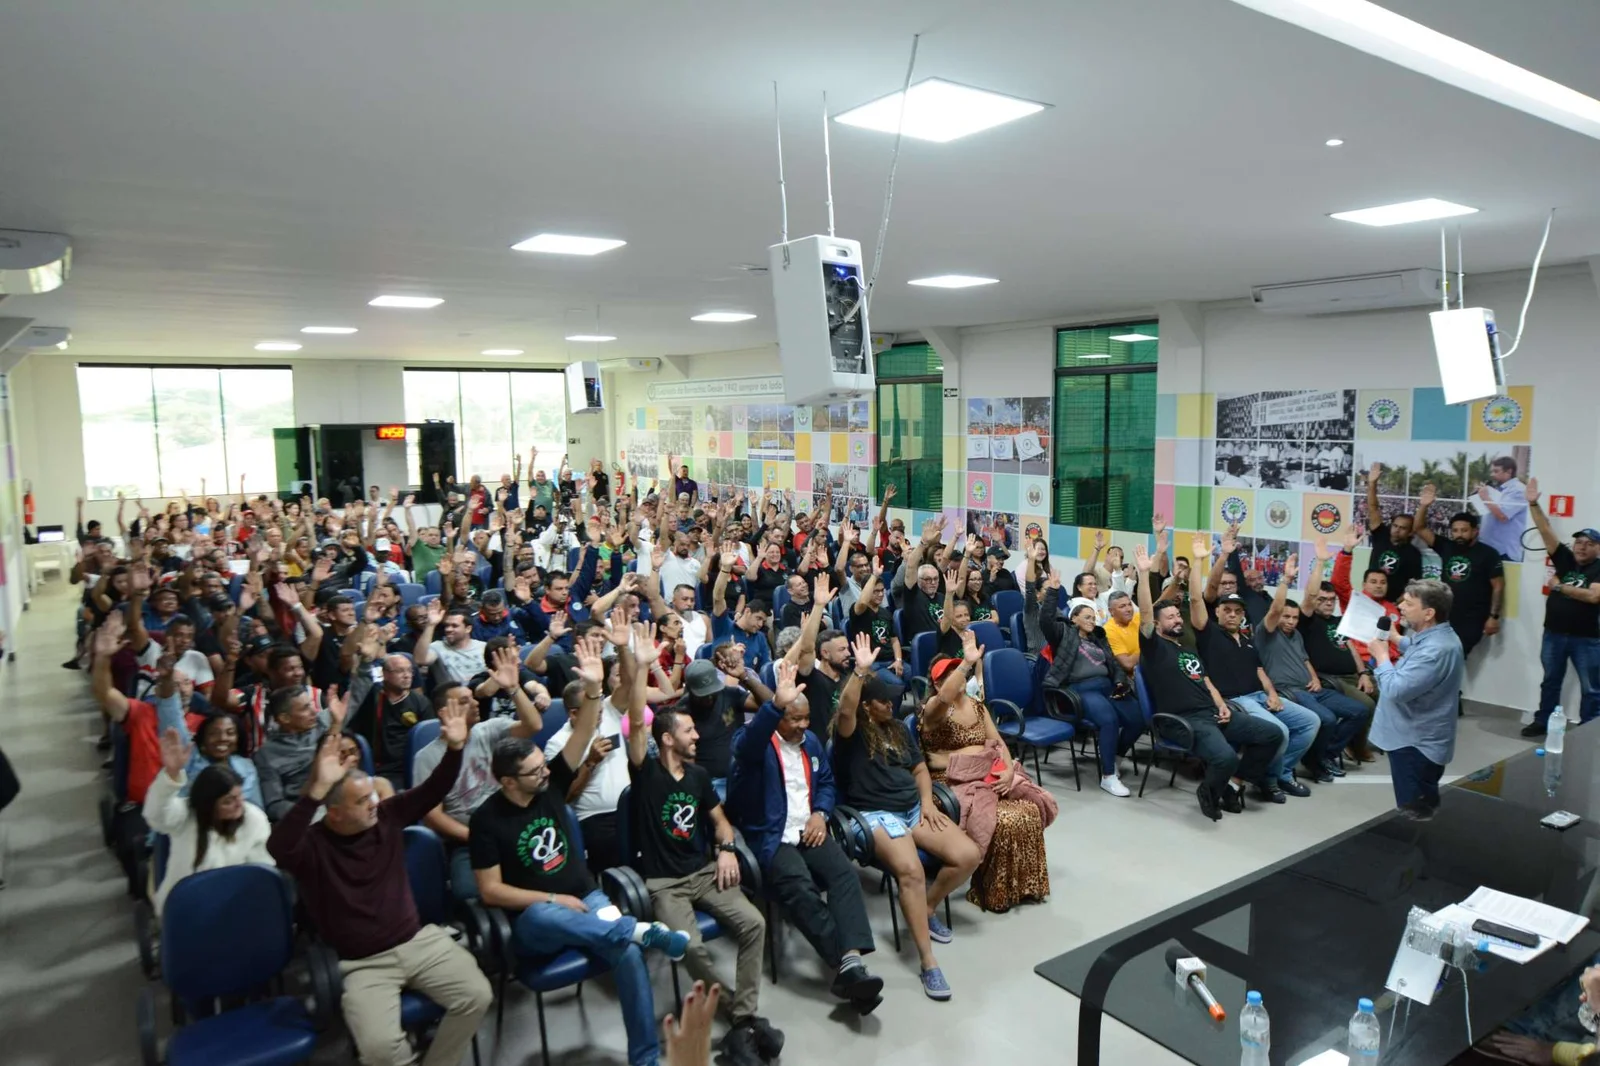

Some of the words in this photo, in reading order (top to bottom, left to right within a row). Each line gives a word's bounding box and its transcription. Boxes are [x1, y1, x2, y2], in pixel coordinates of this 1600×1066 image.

[707, 384, 724, 393] Desde
[724, 383, 738, 392] 1942
[739, 383, 759, 393] sempre
[760, 383, 768, 391] ao
[768, 381, 783, 390] lado
[1184, 658, 1202, 674] 82
[673, 803, 695, 829] 82
[528, 826, 564, 861] 82
